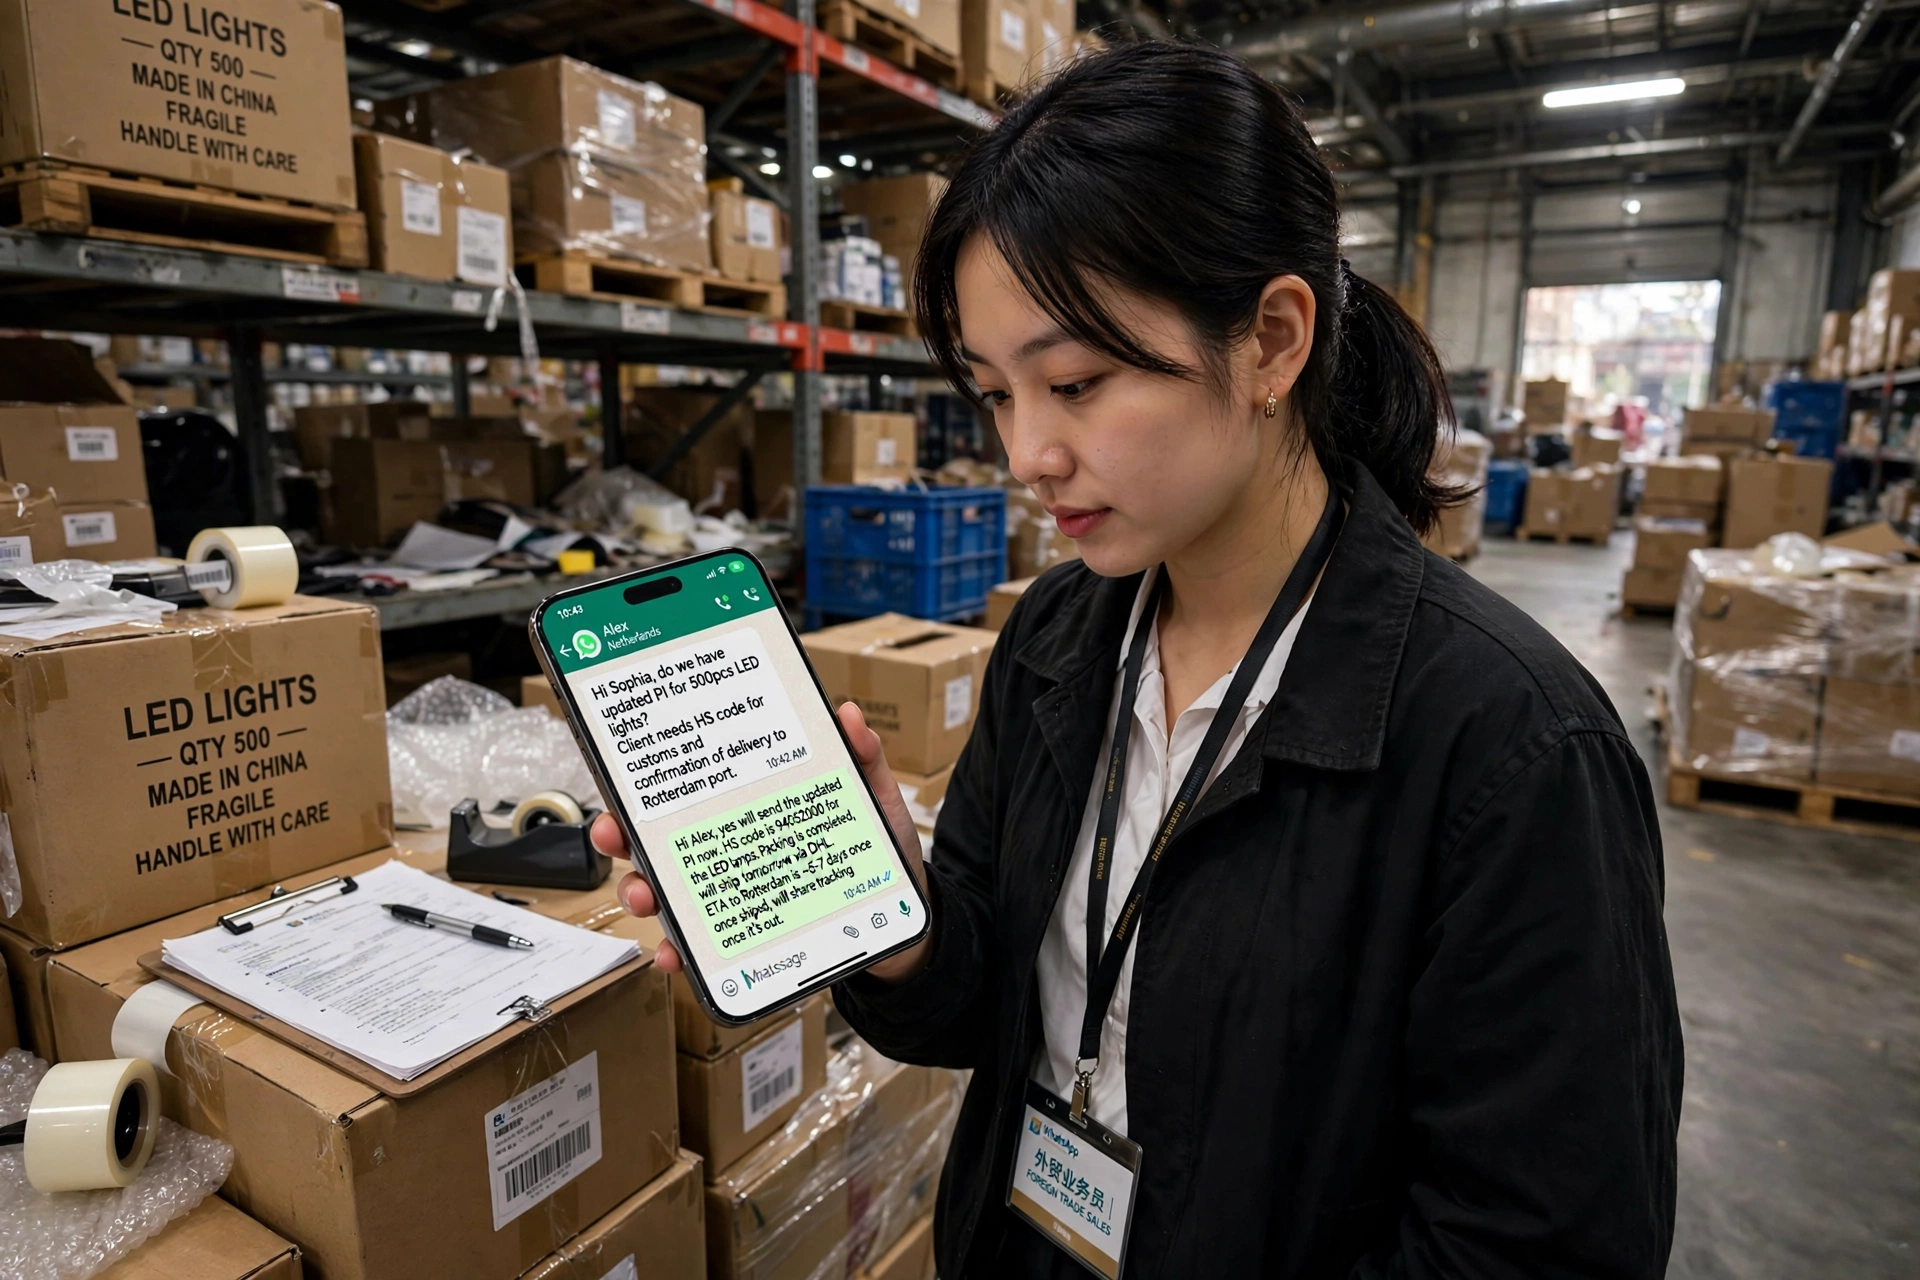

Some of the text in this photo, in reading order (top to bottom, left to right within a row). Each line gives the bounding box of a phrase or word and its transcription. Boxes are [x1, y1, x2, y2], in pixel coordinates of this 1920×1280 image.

[183, 2, 287, 57] LIGHTS
[160, 39, 244, 78] QTY 500
[132, 62, 278, 116] MADE IN CHINA
[166, 100, 247, 136] FRAGILE
[120, 120, 298, 174] HANDLE WITH CARE
[557, 604, 584, 619] 10:43
[603, 621, 630, 637] Alex
[607, 626, 662, 651] Netherlands
[591, 649, 726, 700] Hi Sophia, do we have
[601, 689, 653, 720] updated
[669, 681, 687, 695] for
[688, 666, 735, 689] 500pcs
[734, 655, 760, 674] LED
[124, 674, 317, 740] LED LIGHTS
[607, 712, 649, 738] lights?
[617, 695, 765, 754] Client needs HS code for
[179, 726, 270, 767] QTY 500
[626, 734, 705, 772] customs and
[634, 729, 787, 790] confirmation of delivery to
[765, 746, 808, 769] 10:42 AM
[148, 750, 308, 808] MADE IN CHINA
[641, 766, 738, 810] Rotterdam port.
[187, 788, 275, 829] FRAGILE
[675, 777, 843, 851] Hi Alex, yes will send the updated
[135, 801, 330, 875] HANDLE WITH CARE
[690, 871, 709, 885] the
[707, 859, 730, 877] LED
[793, 830, 805, 841] is
[696, 847, 723, 863] now.
[722, 837, 740, 853] HS
[740, 828, 765, 845] code
[764, 823, 776, 836] is
[698, 882, 718, 900] will
[718, 876, 741, 892] ship
[704, 898, 730, 917] ETA
[728, 896, 741, 907] to
[740, 874, 792, 901] Rotterdam
[790, 869, 801, 879] is
[826, 850, 849, 865] days
[848, 839, 873, 855] once
[714, 916, 738, 932] once
[789, 882, 817, 899] share
[815, 866, 855, 888] tracking
[866, 875, 882, 891] AM
[722, 931, 747, 948] once
[763, 914, 785, 930] out.
[1026, 1168, 1059, 1199] FOREIGN
[1059, 1191, 1086, 1218] TRADE
[1086, 1211, 1112, 1236] SALES
[1034, 1147, 1105, 1214] 外贸业务员
